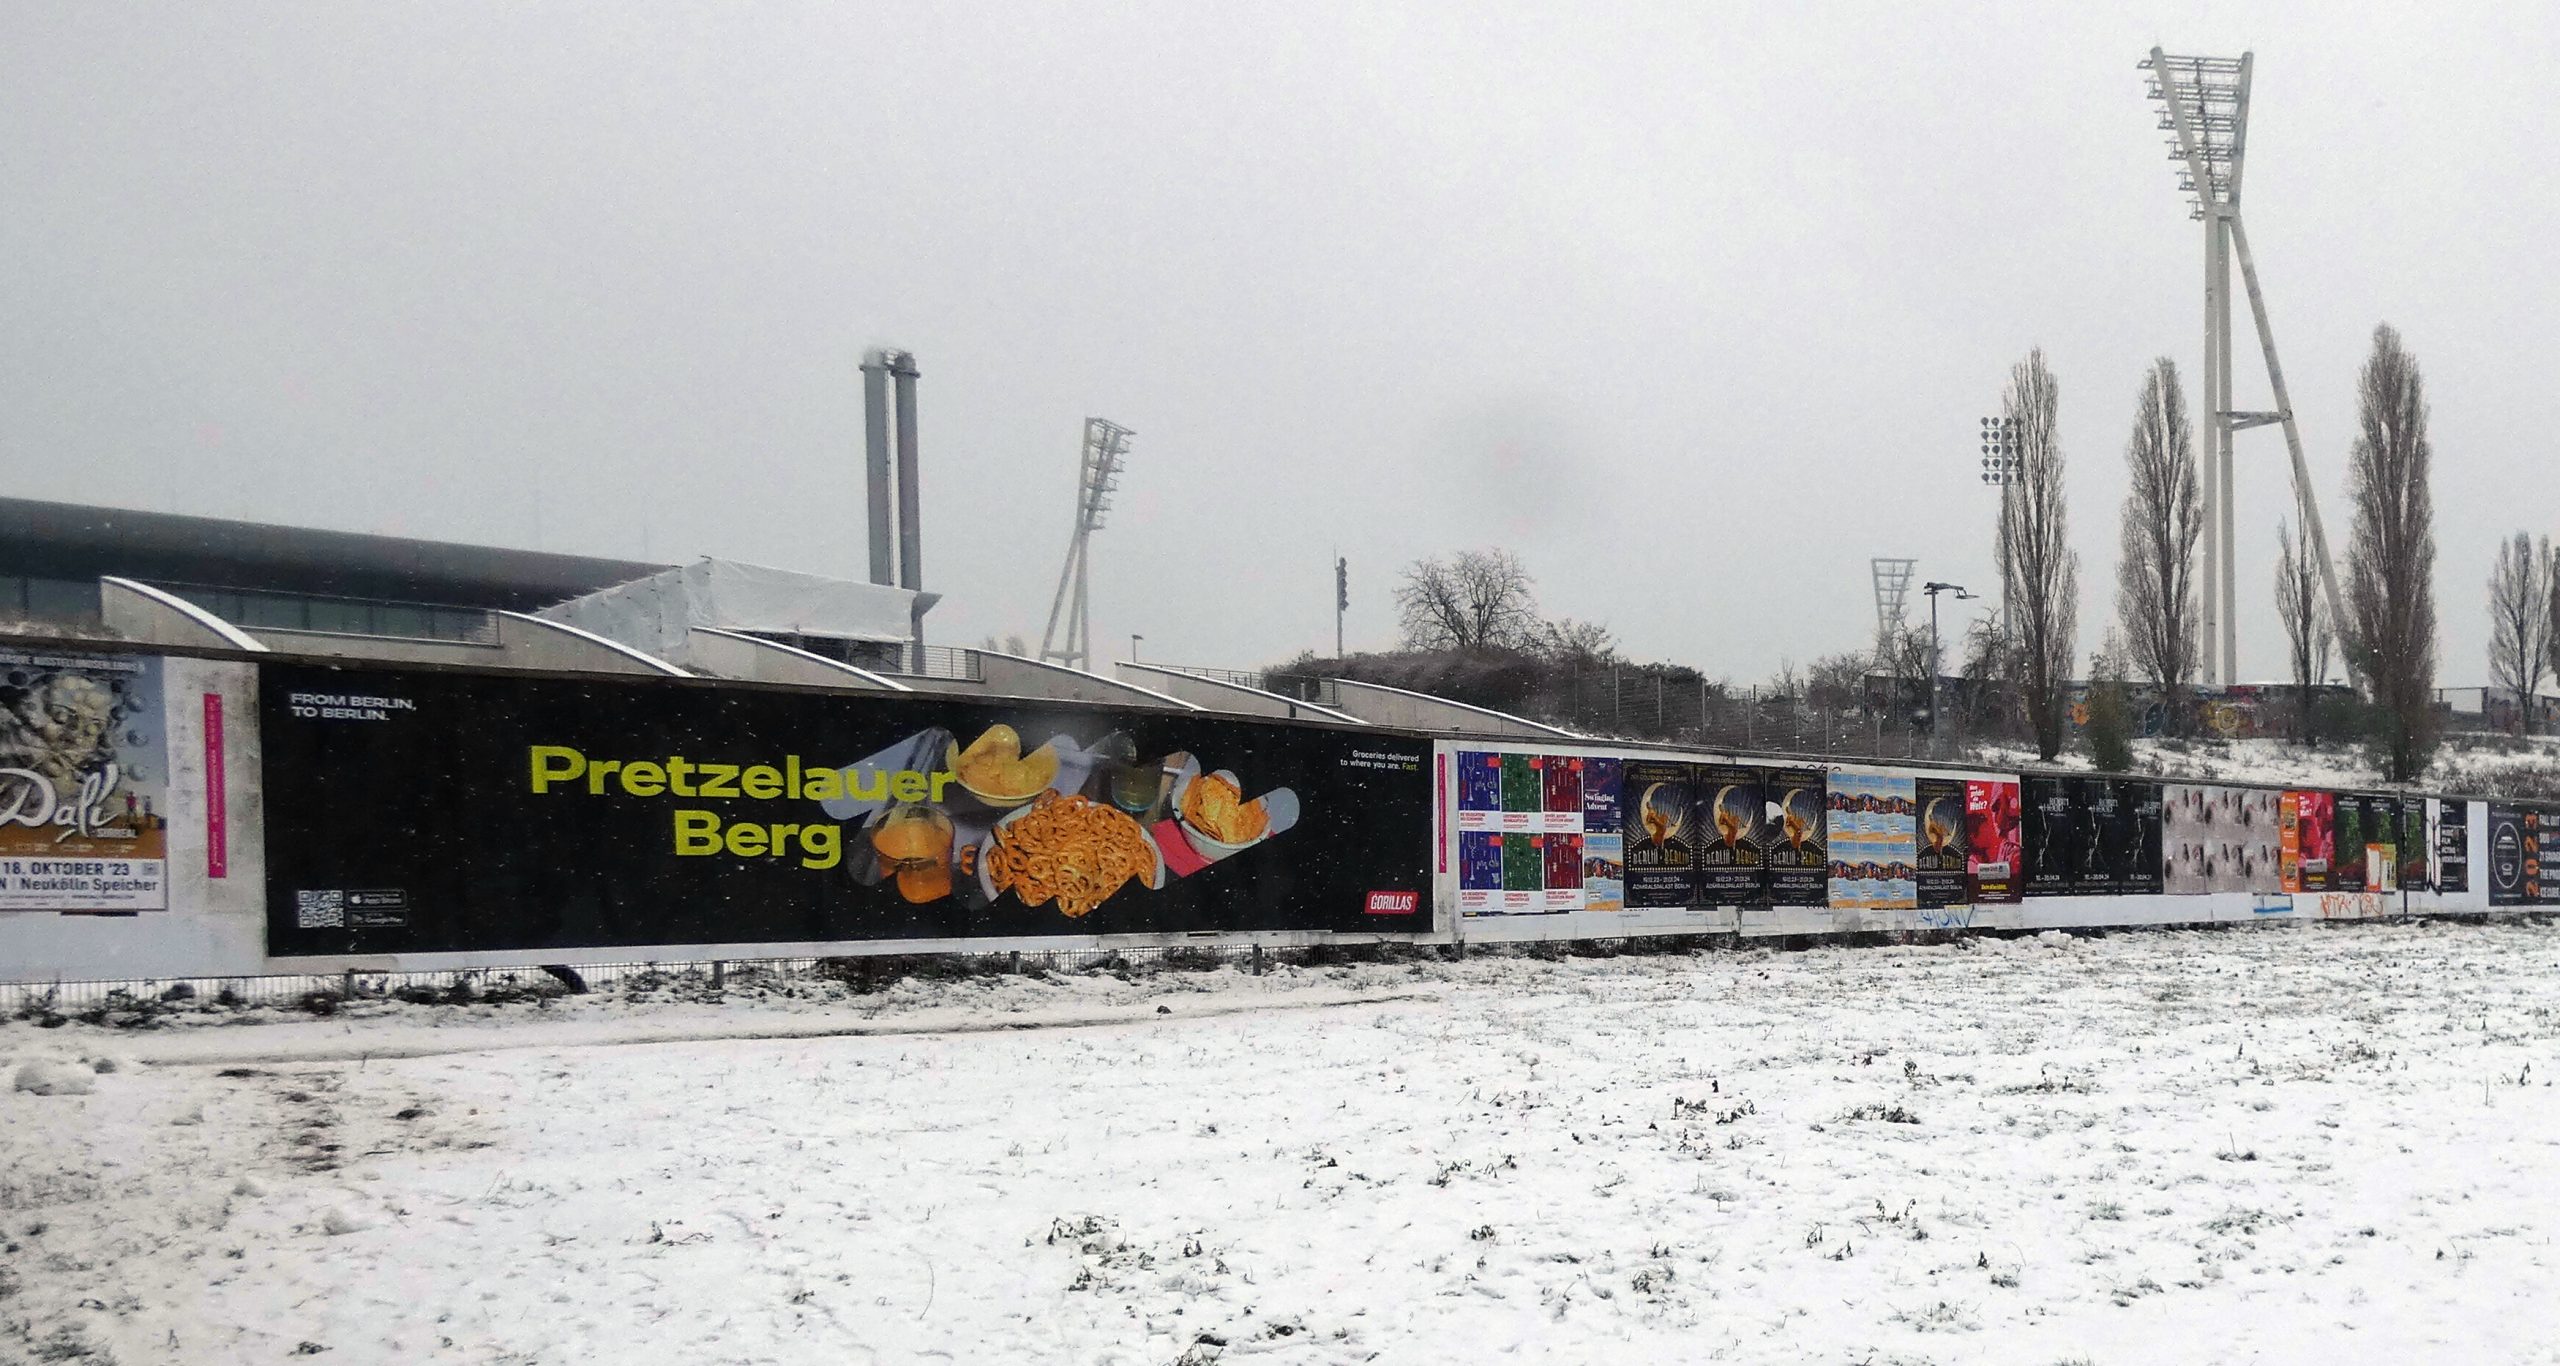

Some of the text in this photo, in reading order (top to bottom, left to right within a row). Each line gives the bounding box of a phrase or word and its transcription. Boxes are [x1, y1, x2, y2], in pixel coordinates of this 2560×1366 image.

[291, 693, 417, 711] FROM BERLIN,
[291, 706, 390, 721] TO BERLIN.
[1352, 749, 1420, 762] Groceries delivered
[1350, 760, 1371, 768] where
[1373, 761, 1386, 769] you
[530, 745, 956, 802] Pretzelauer
[674, 810, 842, 870] Berg
[4, 862, 26, 875] 18.
[31, 862, 104, 876] OKTOBER
[20, 878, 89, 892] Neukölln
[93, 880, 158, 894] Speicher
[1370, 894, 1413, 911] GORILLAS
